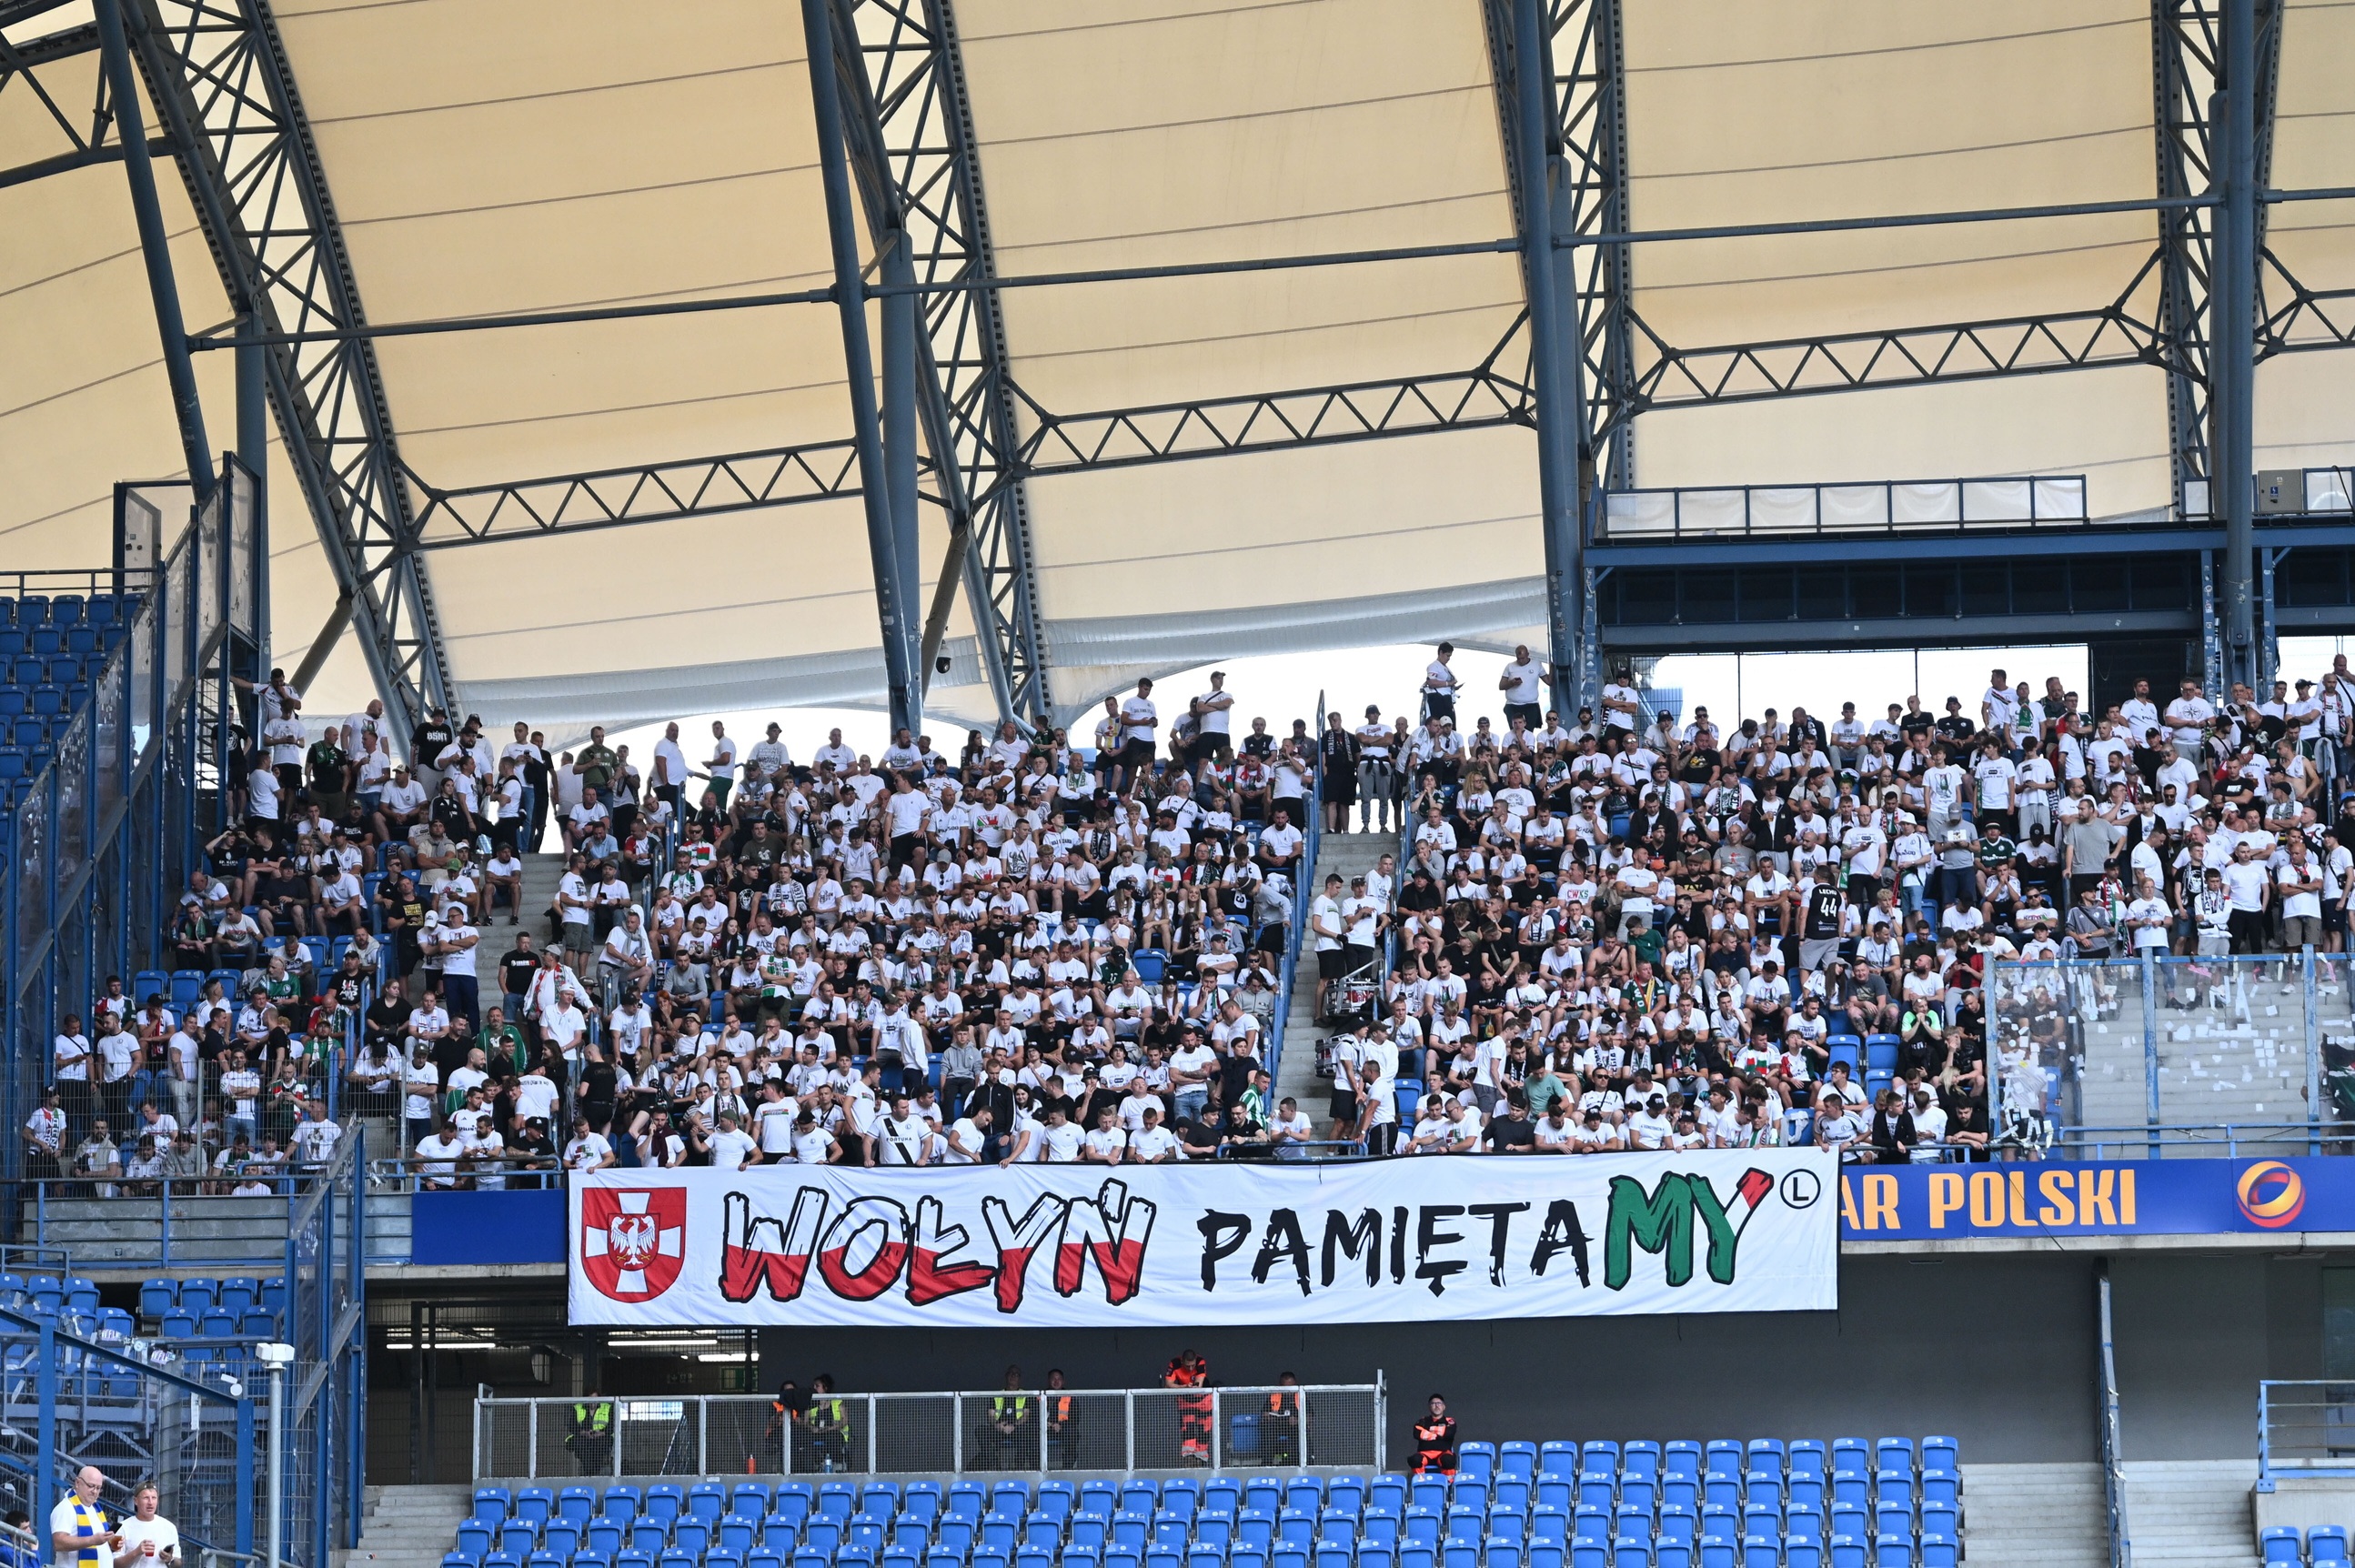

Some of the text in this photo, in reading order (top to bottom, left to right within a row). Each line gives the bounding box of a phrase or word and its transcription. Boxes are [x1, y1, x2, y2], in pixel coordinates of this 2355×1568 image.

[1566, 890, 1589, 900] CWKS
[1820, 897, 1837, 919] 44
[1928, 1169, 2137, 1229] POLSKI
[719, 1178, 1157, 1312] WOŁYŃ
